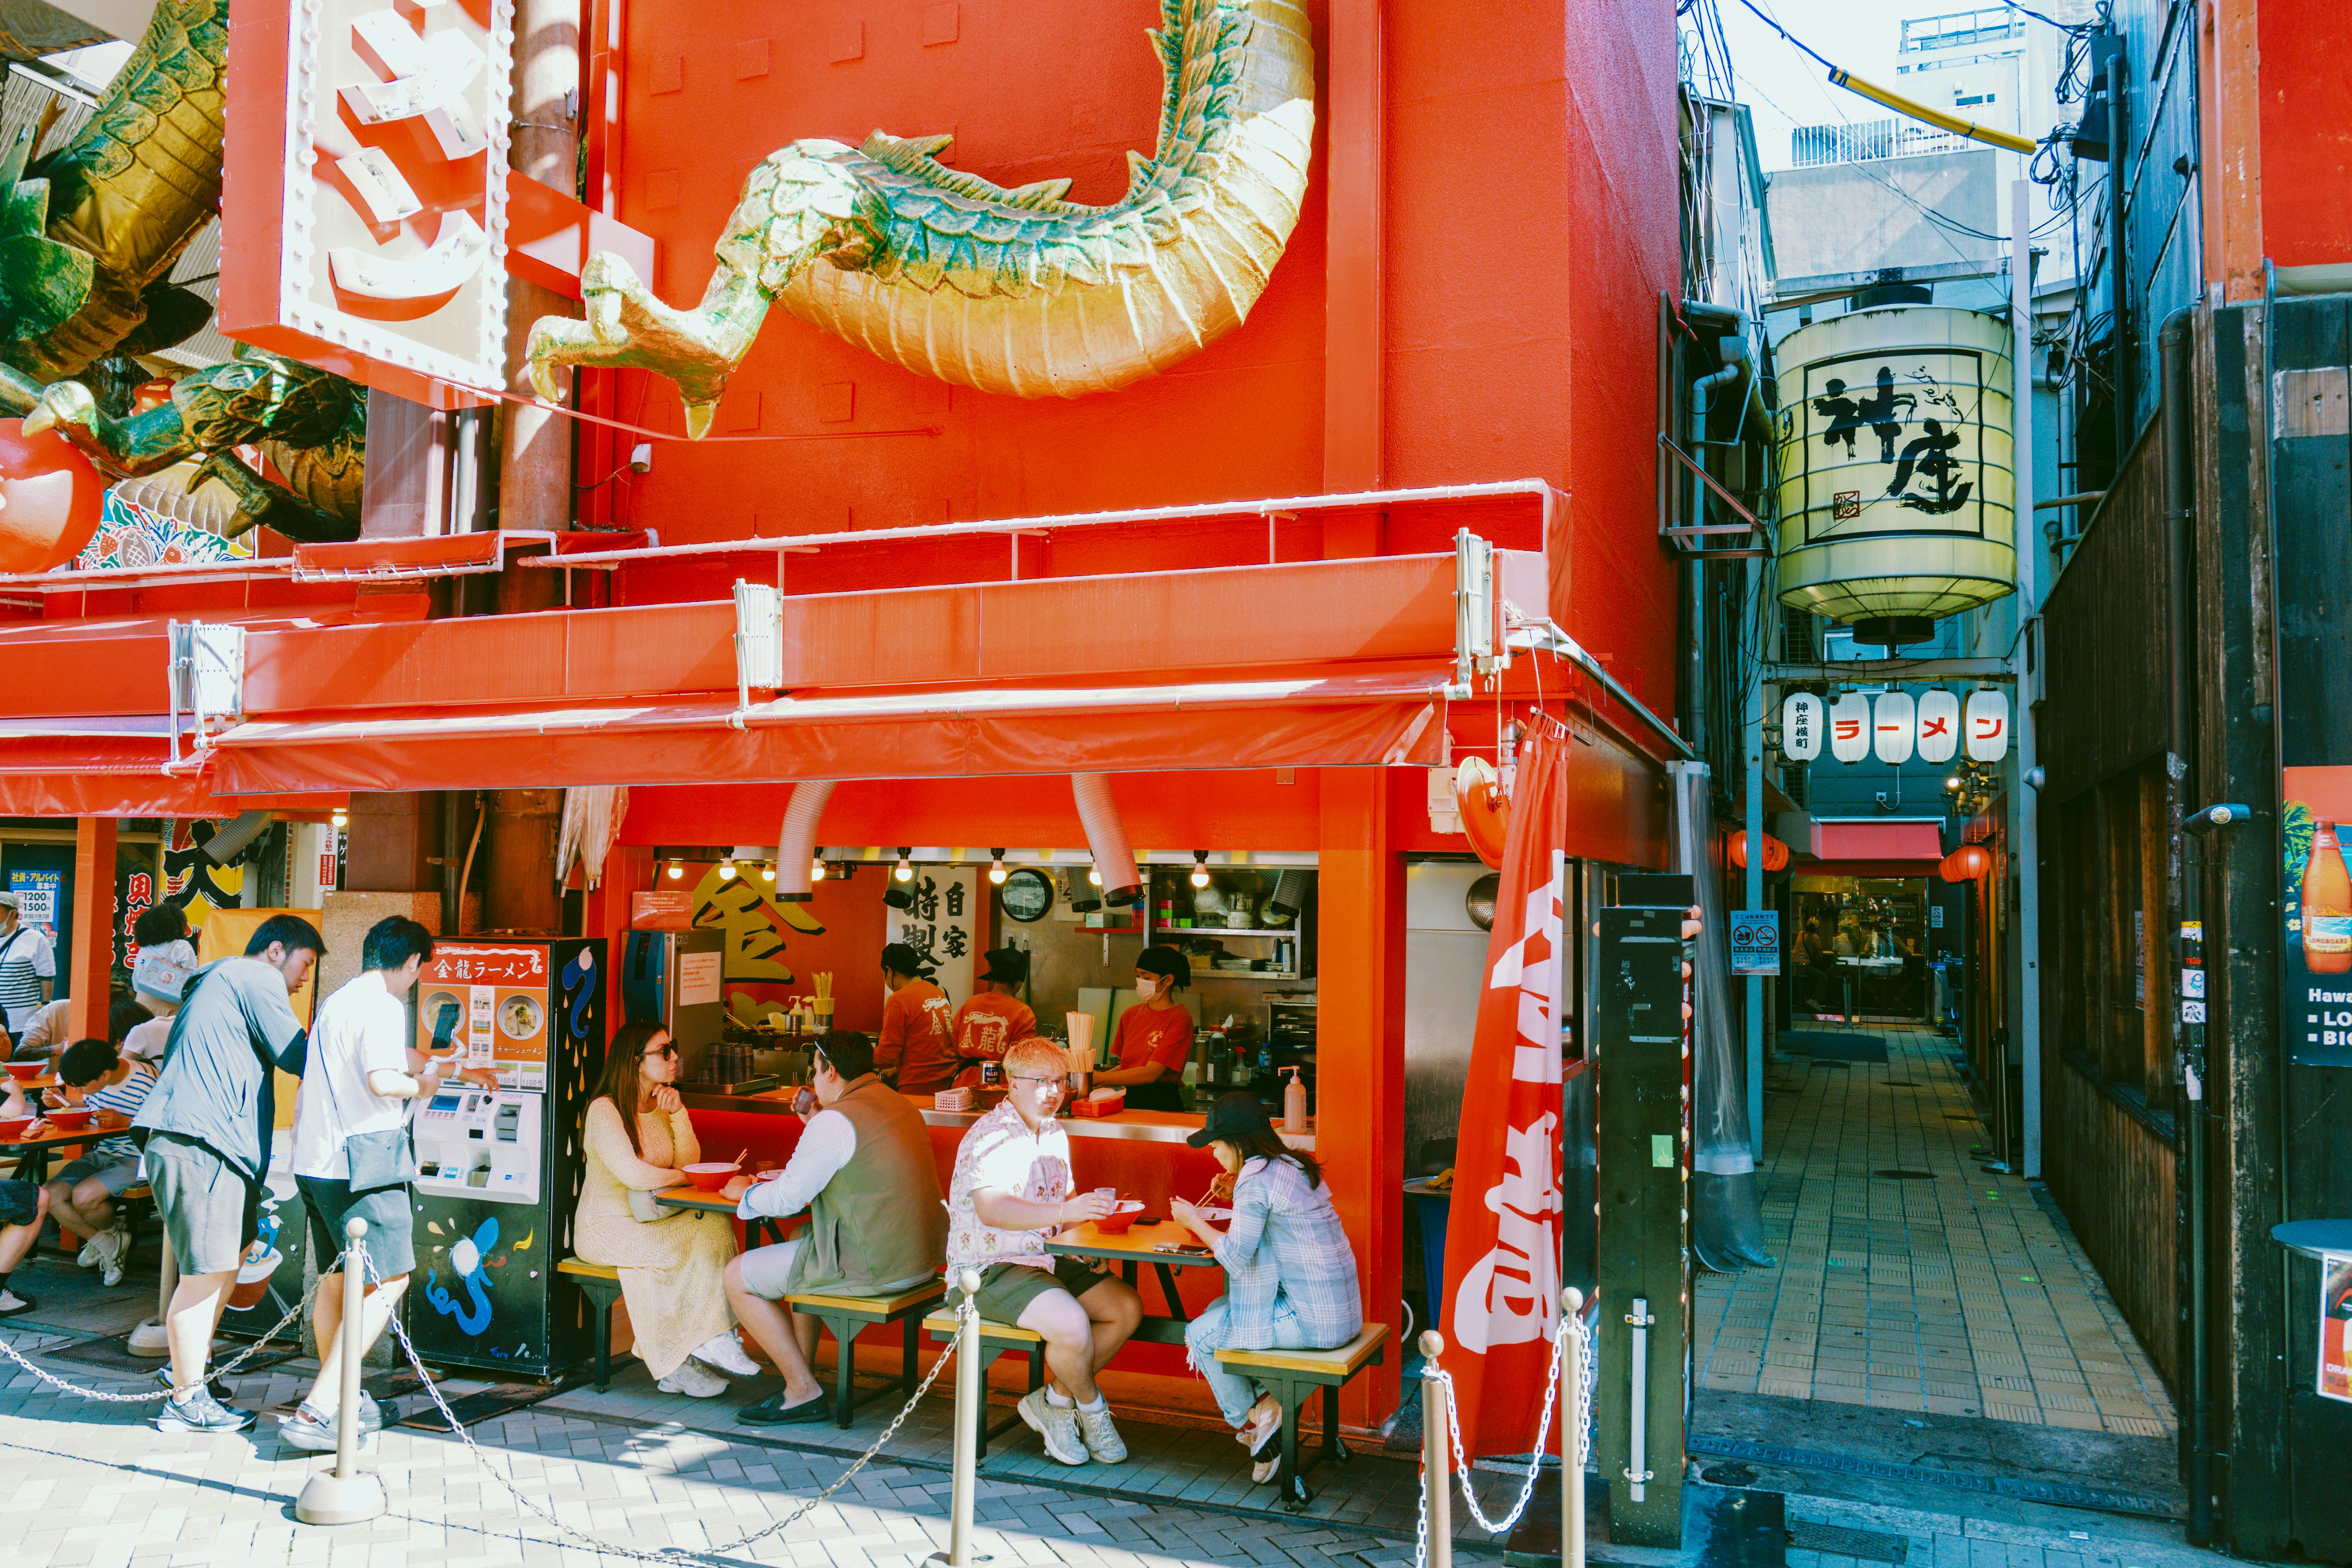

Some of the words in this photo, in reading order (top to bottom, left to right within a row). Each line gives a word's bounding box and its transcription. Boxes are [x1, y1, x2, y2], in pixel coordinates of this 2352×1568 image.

[328, 0, 490, 322] メン
[1795, 701, 1808, 749] 神座横町
[1835, 717, 2002, 740] ラーメン
[12, 872, 59, 882] 社員・アルバイト
[941, 881, 968, 958] 自家
[434, 959, 529, 980] 金龍ラーメン
[496, 1045, 543, 1054] チャーシューメン
[959, 1023, 997, 1053] 金龍
